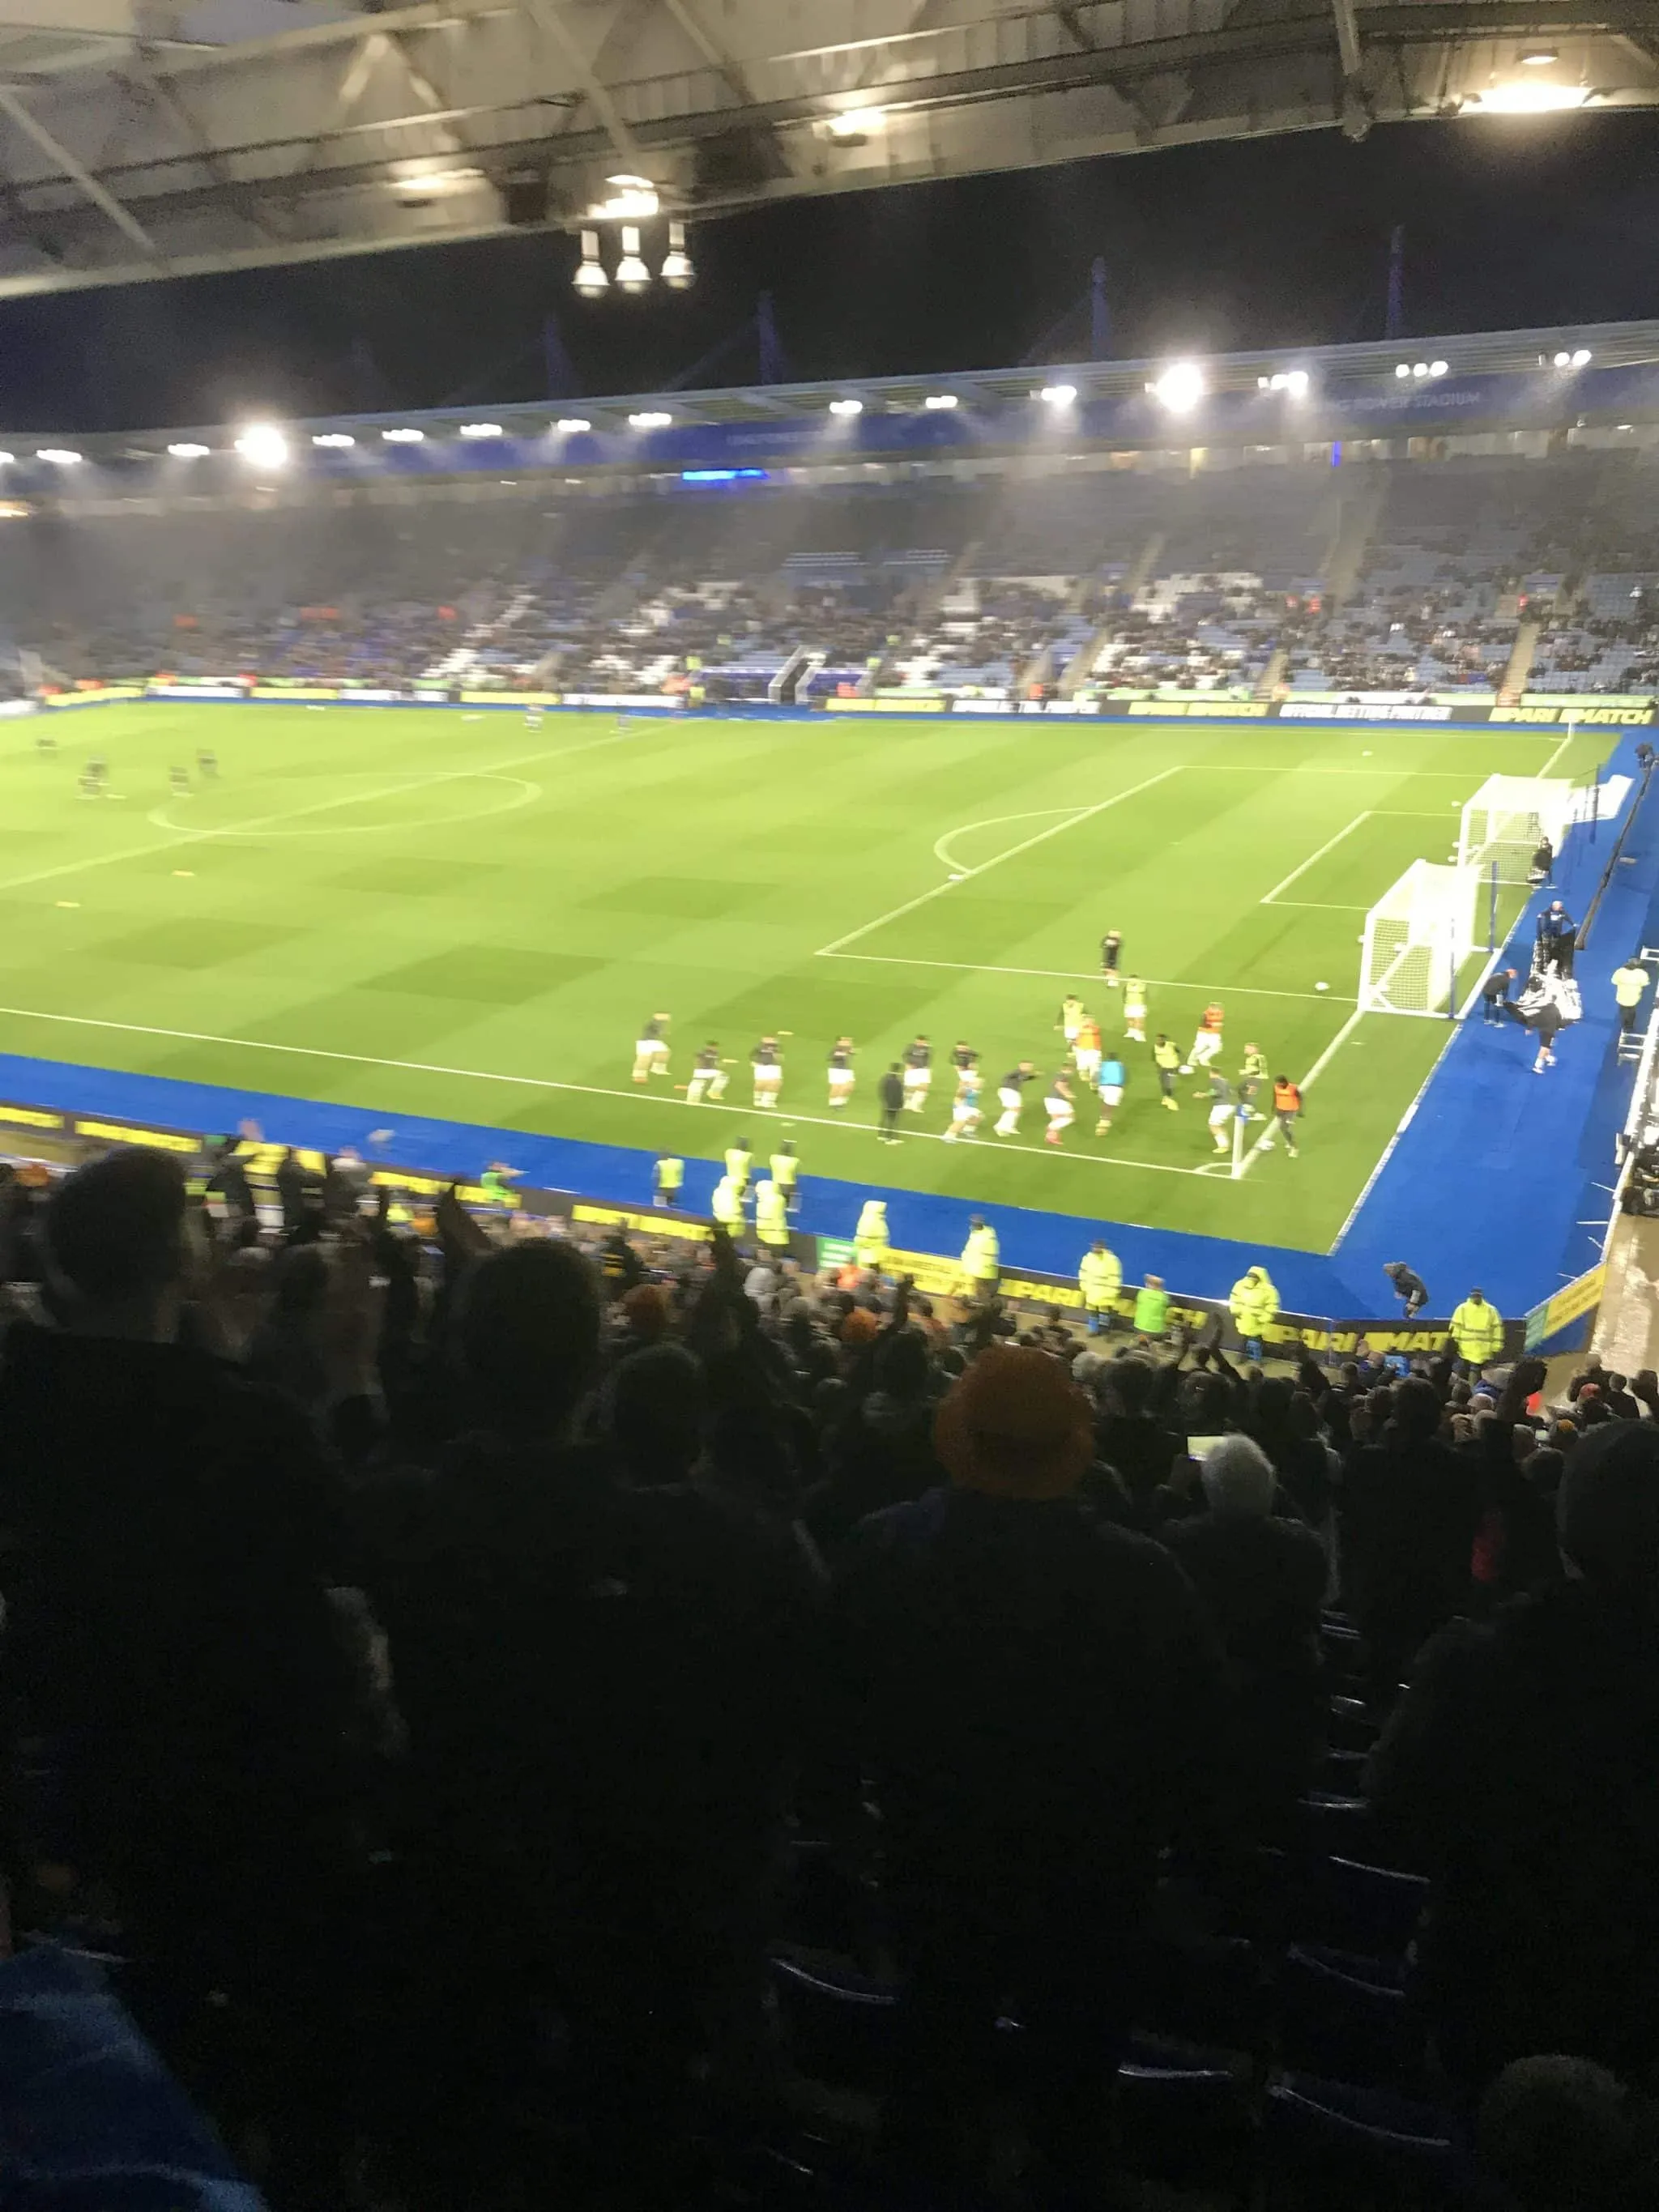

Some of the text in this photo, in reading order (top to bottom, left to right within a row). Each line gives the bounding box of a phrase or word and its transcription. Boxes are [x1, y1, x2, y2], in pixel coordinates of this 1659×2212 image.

[1416, 390, 1481, 407] STADIUM
[1564, 708, 1654, 724] MATCH
[1374, 1332, 1449, 1352] MAT
